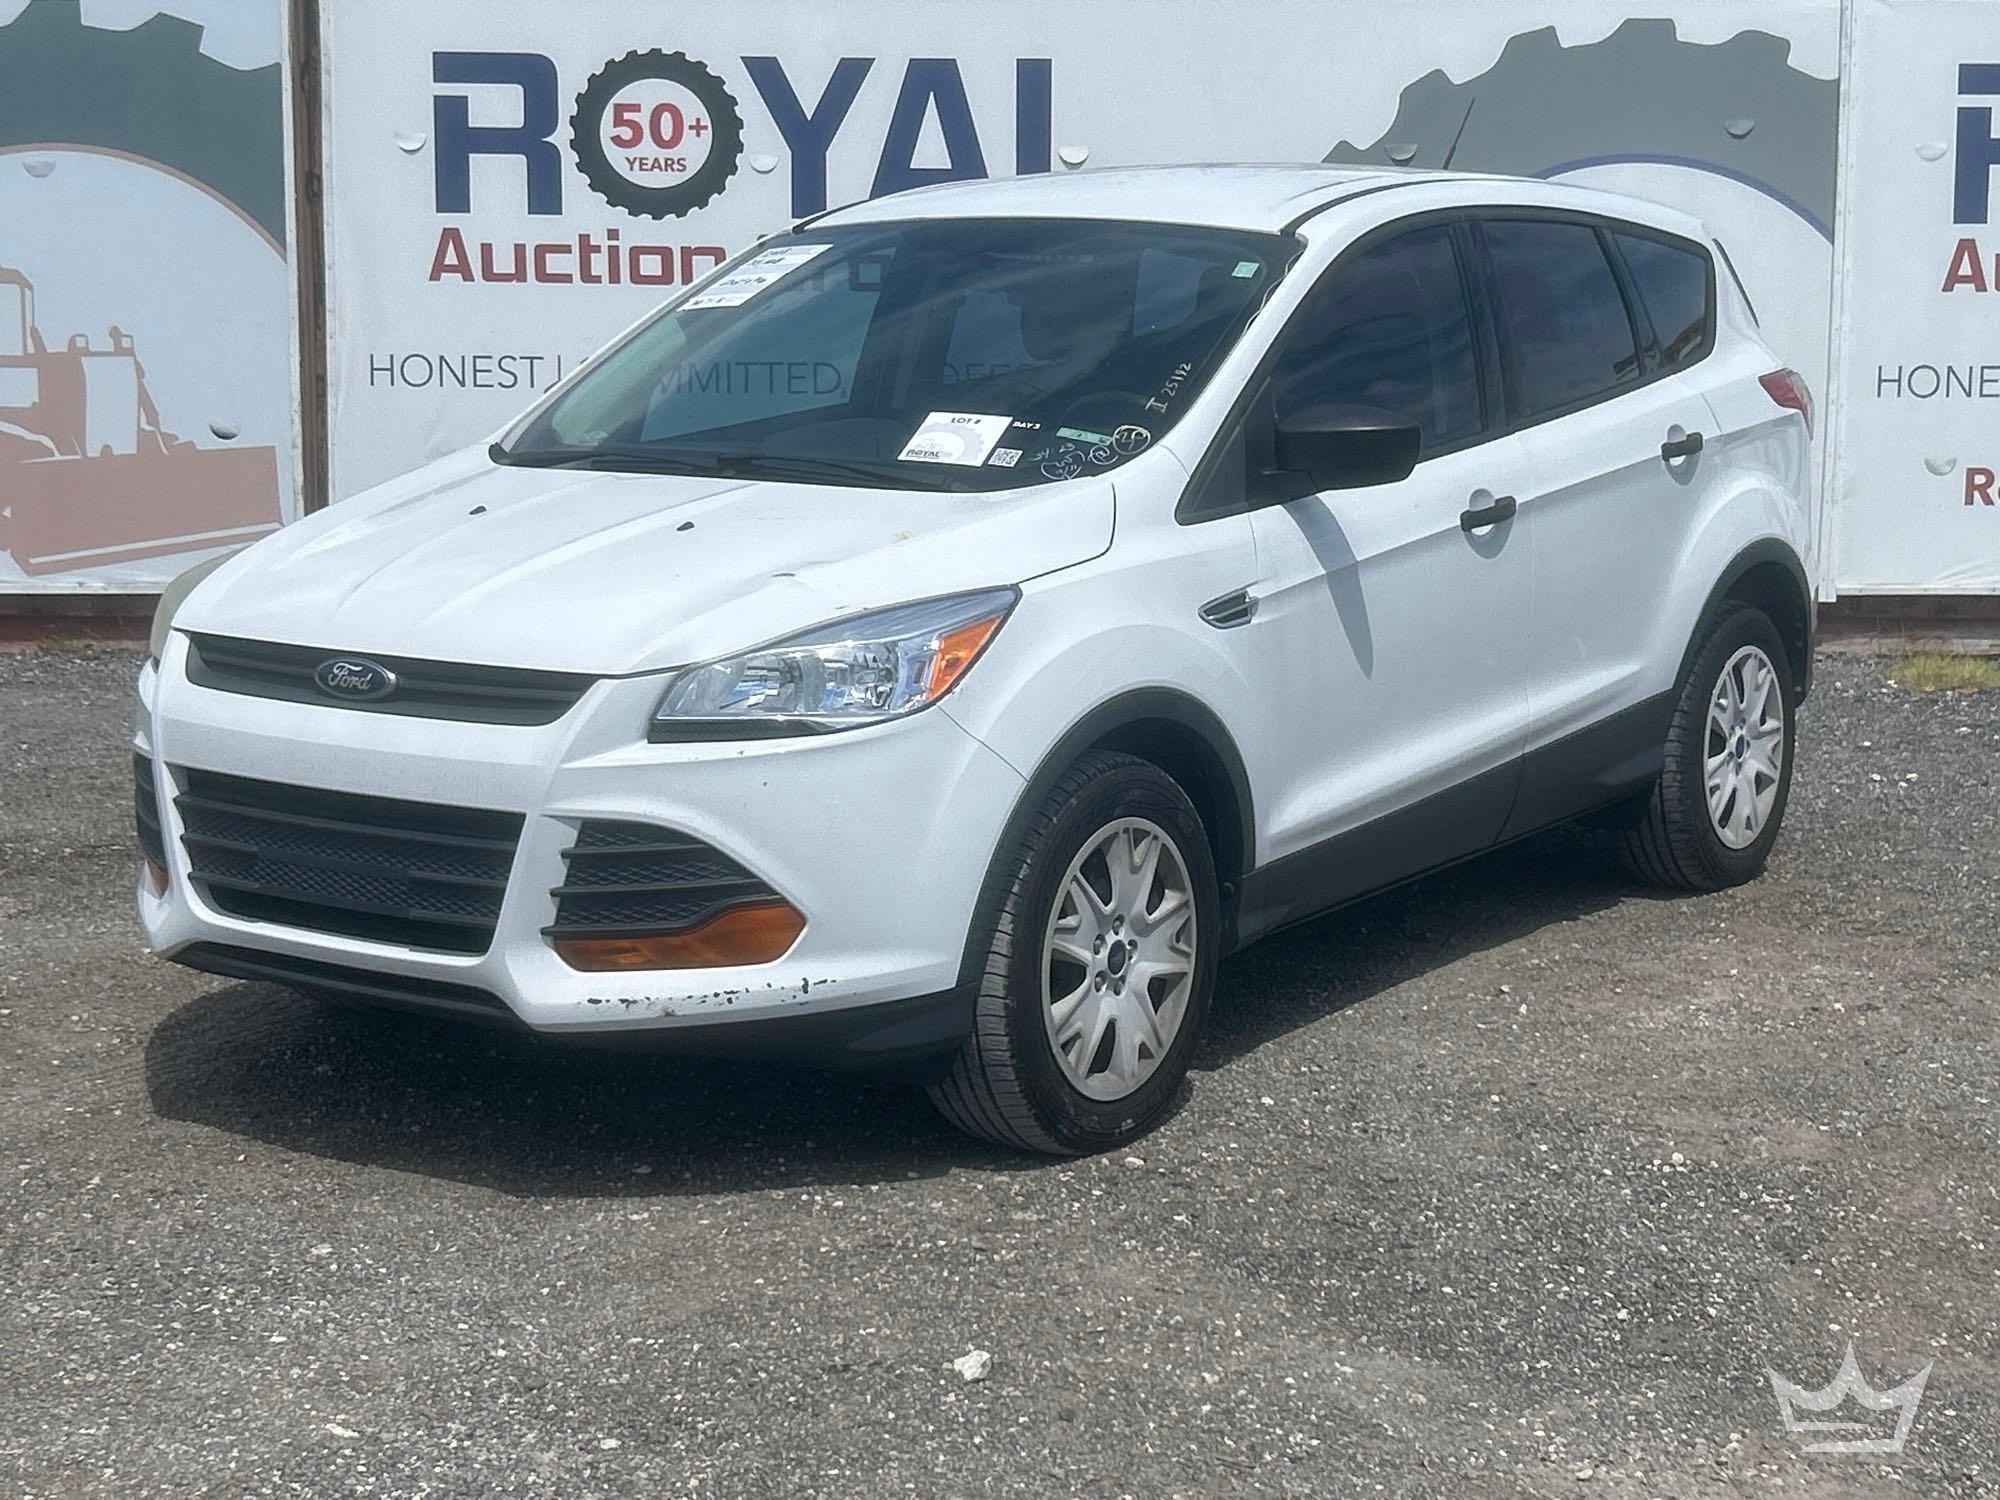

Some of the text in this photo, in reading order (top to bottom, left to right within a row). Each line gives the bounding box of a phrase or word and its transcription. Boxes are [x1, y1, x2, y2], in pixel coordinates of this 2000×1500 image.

[610, 103, 709, 150] 50+
[625, 157, 687, 173] YEARS
[428, 227, 727, 285] Auction
[369, 353, 545, 389] HONEST
[328, 662, 373, 690] Ford
